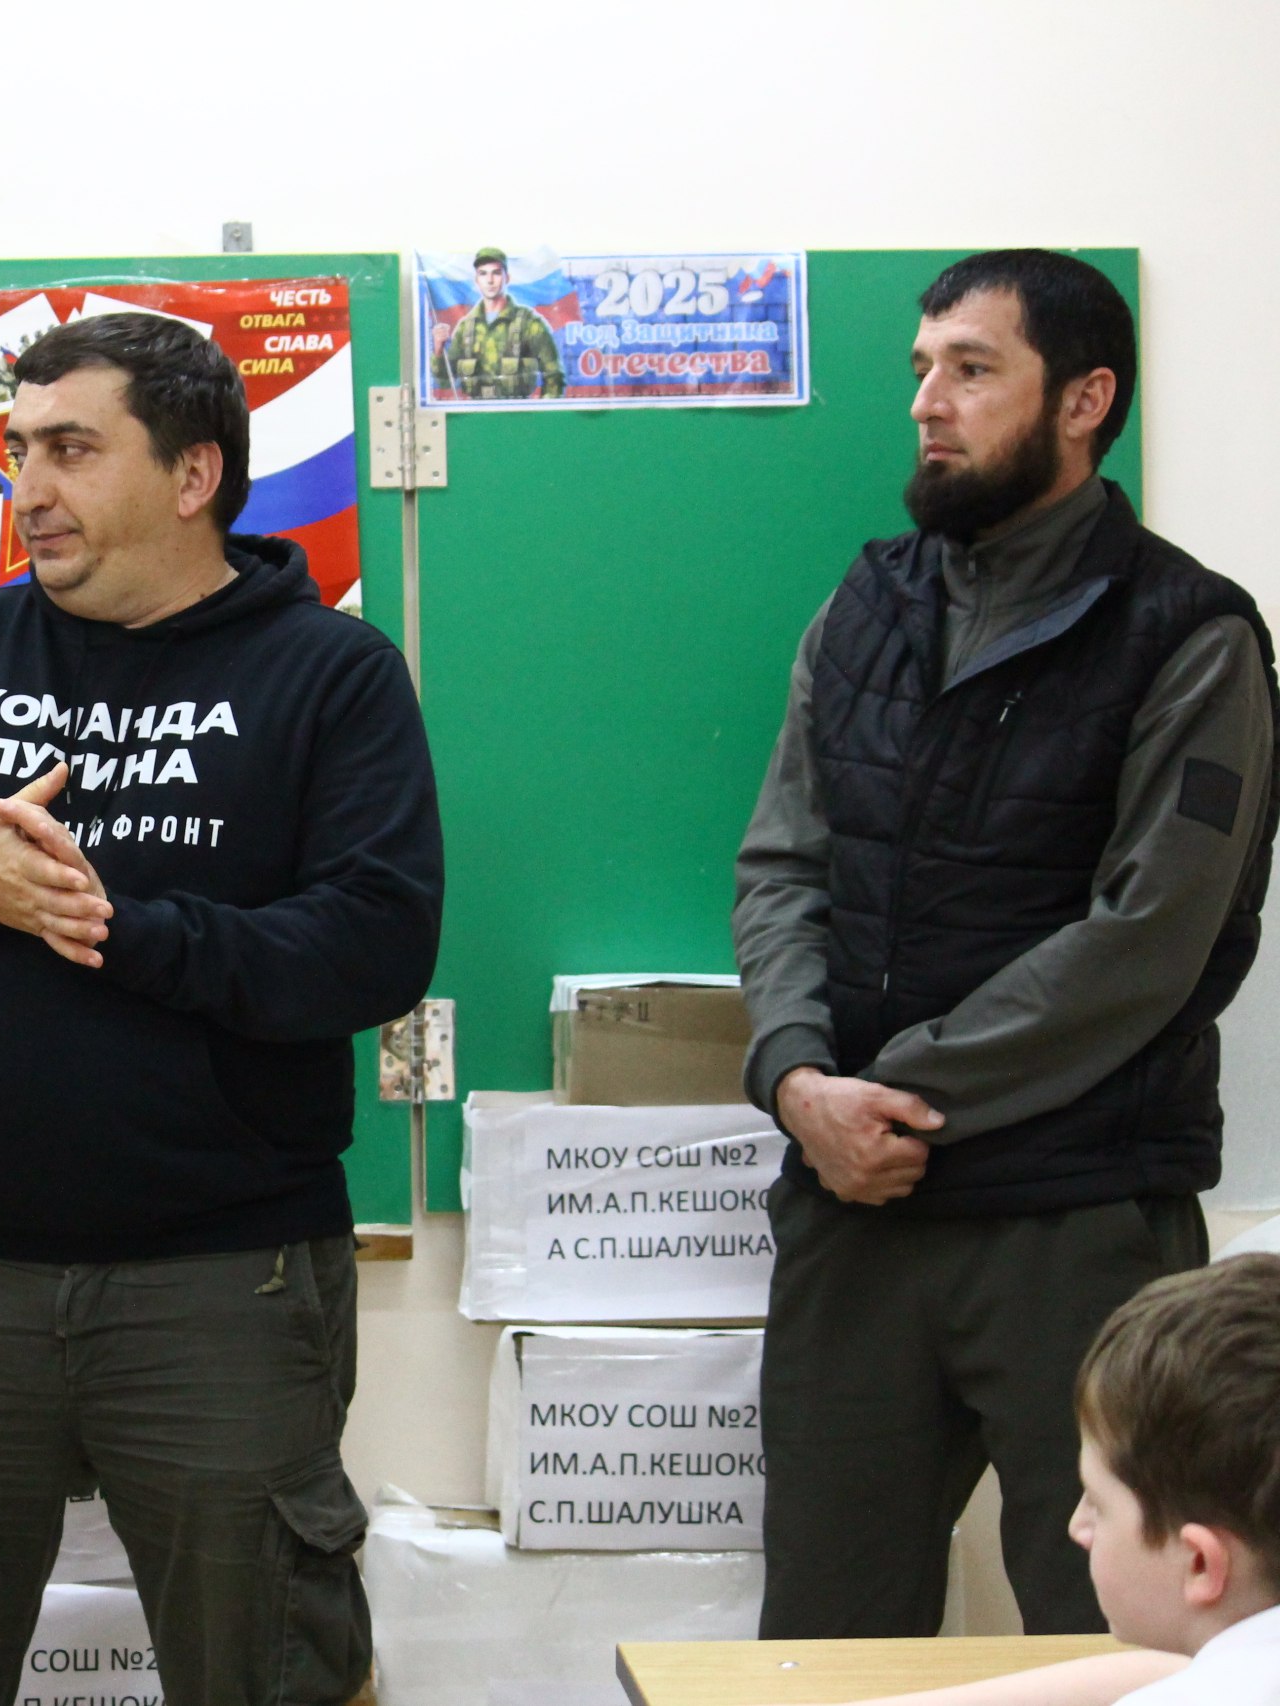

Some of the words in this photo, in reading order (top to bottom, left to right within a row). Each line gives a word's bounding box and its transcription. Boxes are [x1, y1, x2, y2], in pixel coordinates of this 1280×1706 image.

[269, 289, 332, 307] ЧЕСТЬ
[594, 268, 731, 317] 2025
[239, 313, 306, 329] ОТВАГА
[566, 322, 619, 346] Год
[621, 319, 779, 346] Защитника
[264, 333, 333, 353] СЛАВА
[239, 357, 295, 376] СИЛА
[580, 349, 771, 377] Отечества
[111, 813, 225, 848] ФРОНТ
[546, 1145, 629, 1170] МКОУ
[636, 1144, 701, 1169] СОШ
[711, 1143, 759, 1167] №2
[548, 1238, 566, 1260] А
[574, 1234, 773, 1260] С.П.ШАЛУШКА
[530, 1403, 620, 1428] МКОУ
[627, 1403, 698, 1428] СОШ
[708, 1404, 759, 1428] №2
[529, 1500, 744, 1525] С.П.ШАЛУШКА
[30, 1648, 99, 1672] СОШ
